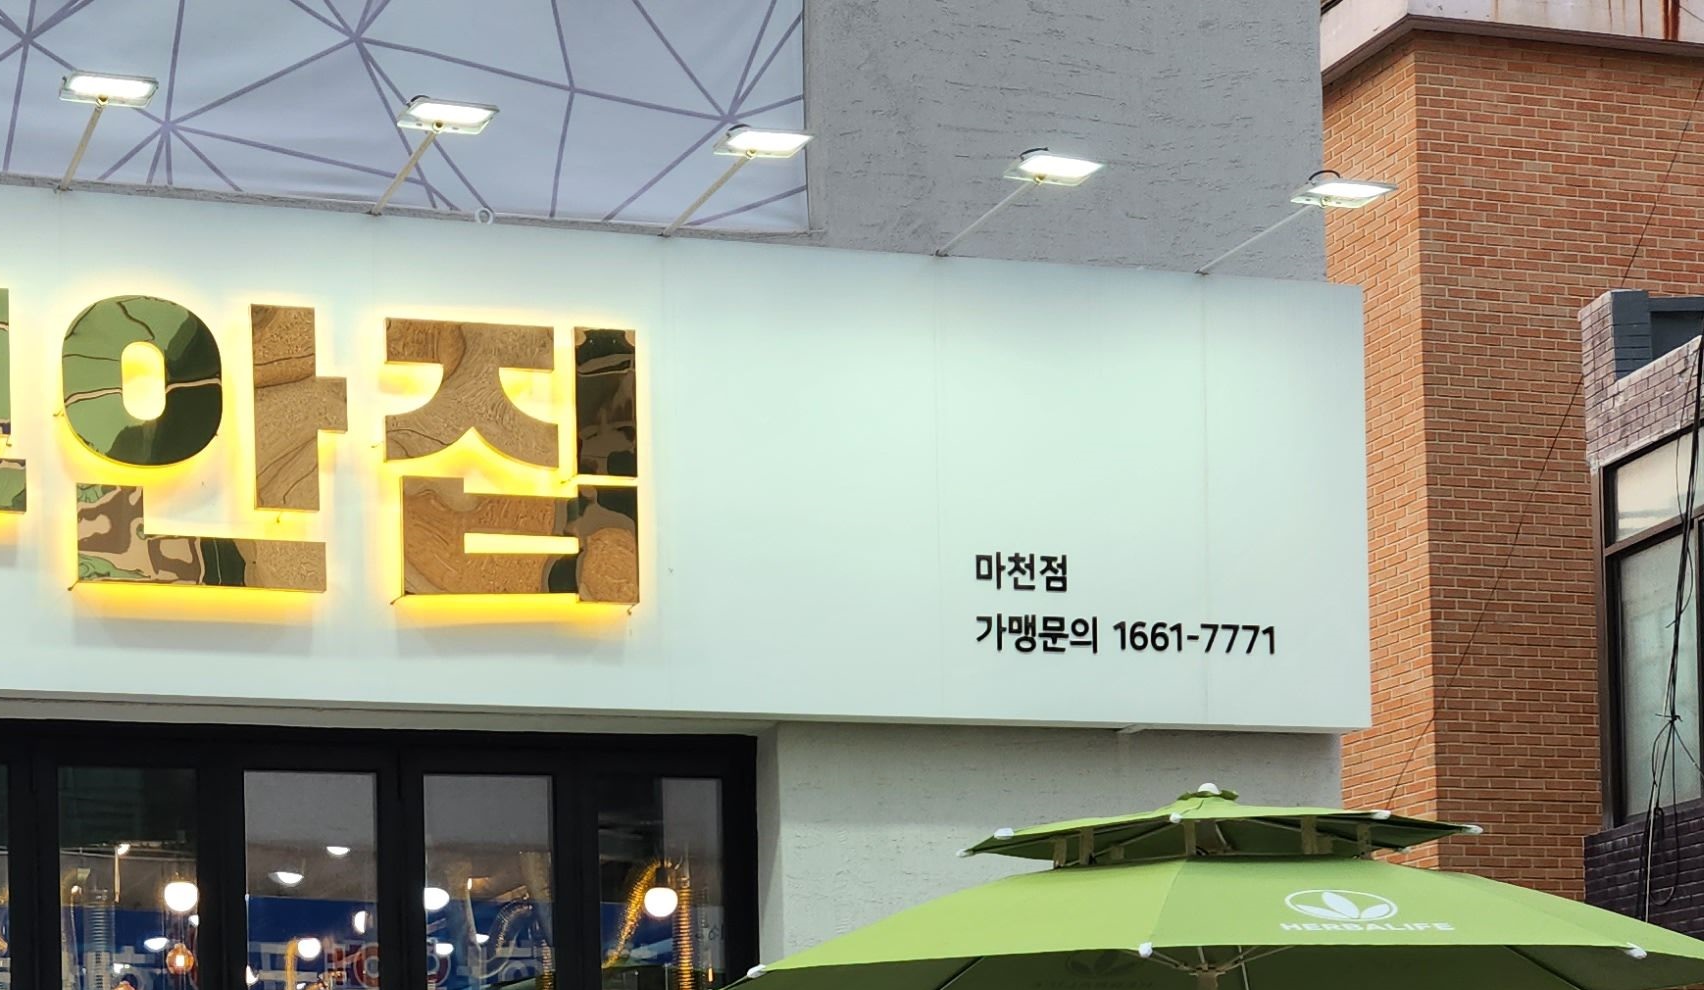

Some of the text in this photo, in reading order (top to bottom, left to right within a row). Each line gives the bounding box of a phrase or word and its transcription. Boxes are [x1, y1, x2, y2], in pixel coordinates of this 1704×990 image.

[975, 551, 1069, 592] 마천점
[975, 613, 1276, 655] 가맹문의 1661-7771
[1280, 922, 1455, 932] HERBALIFE
